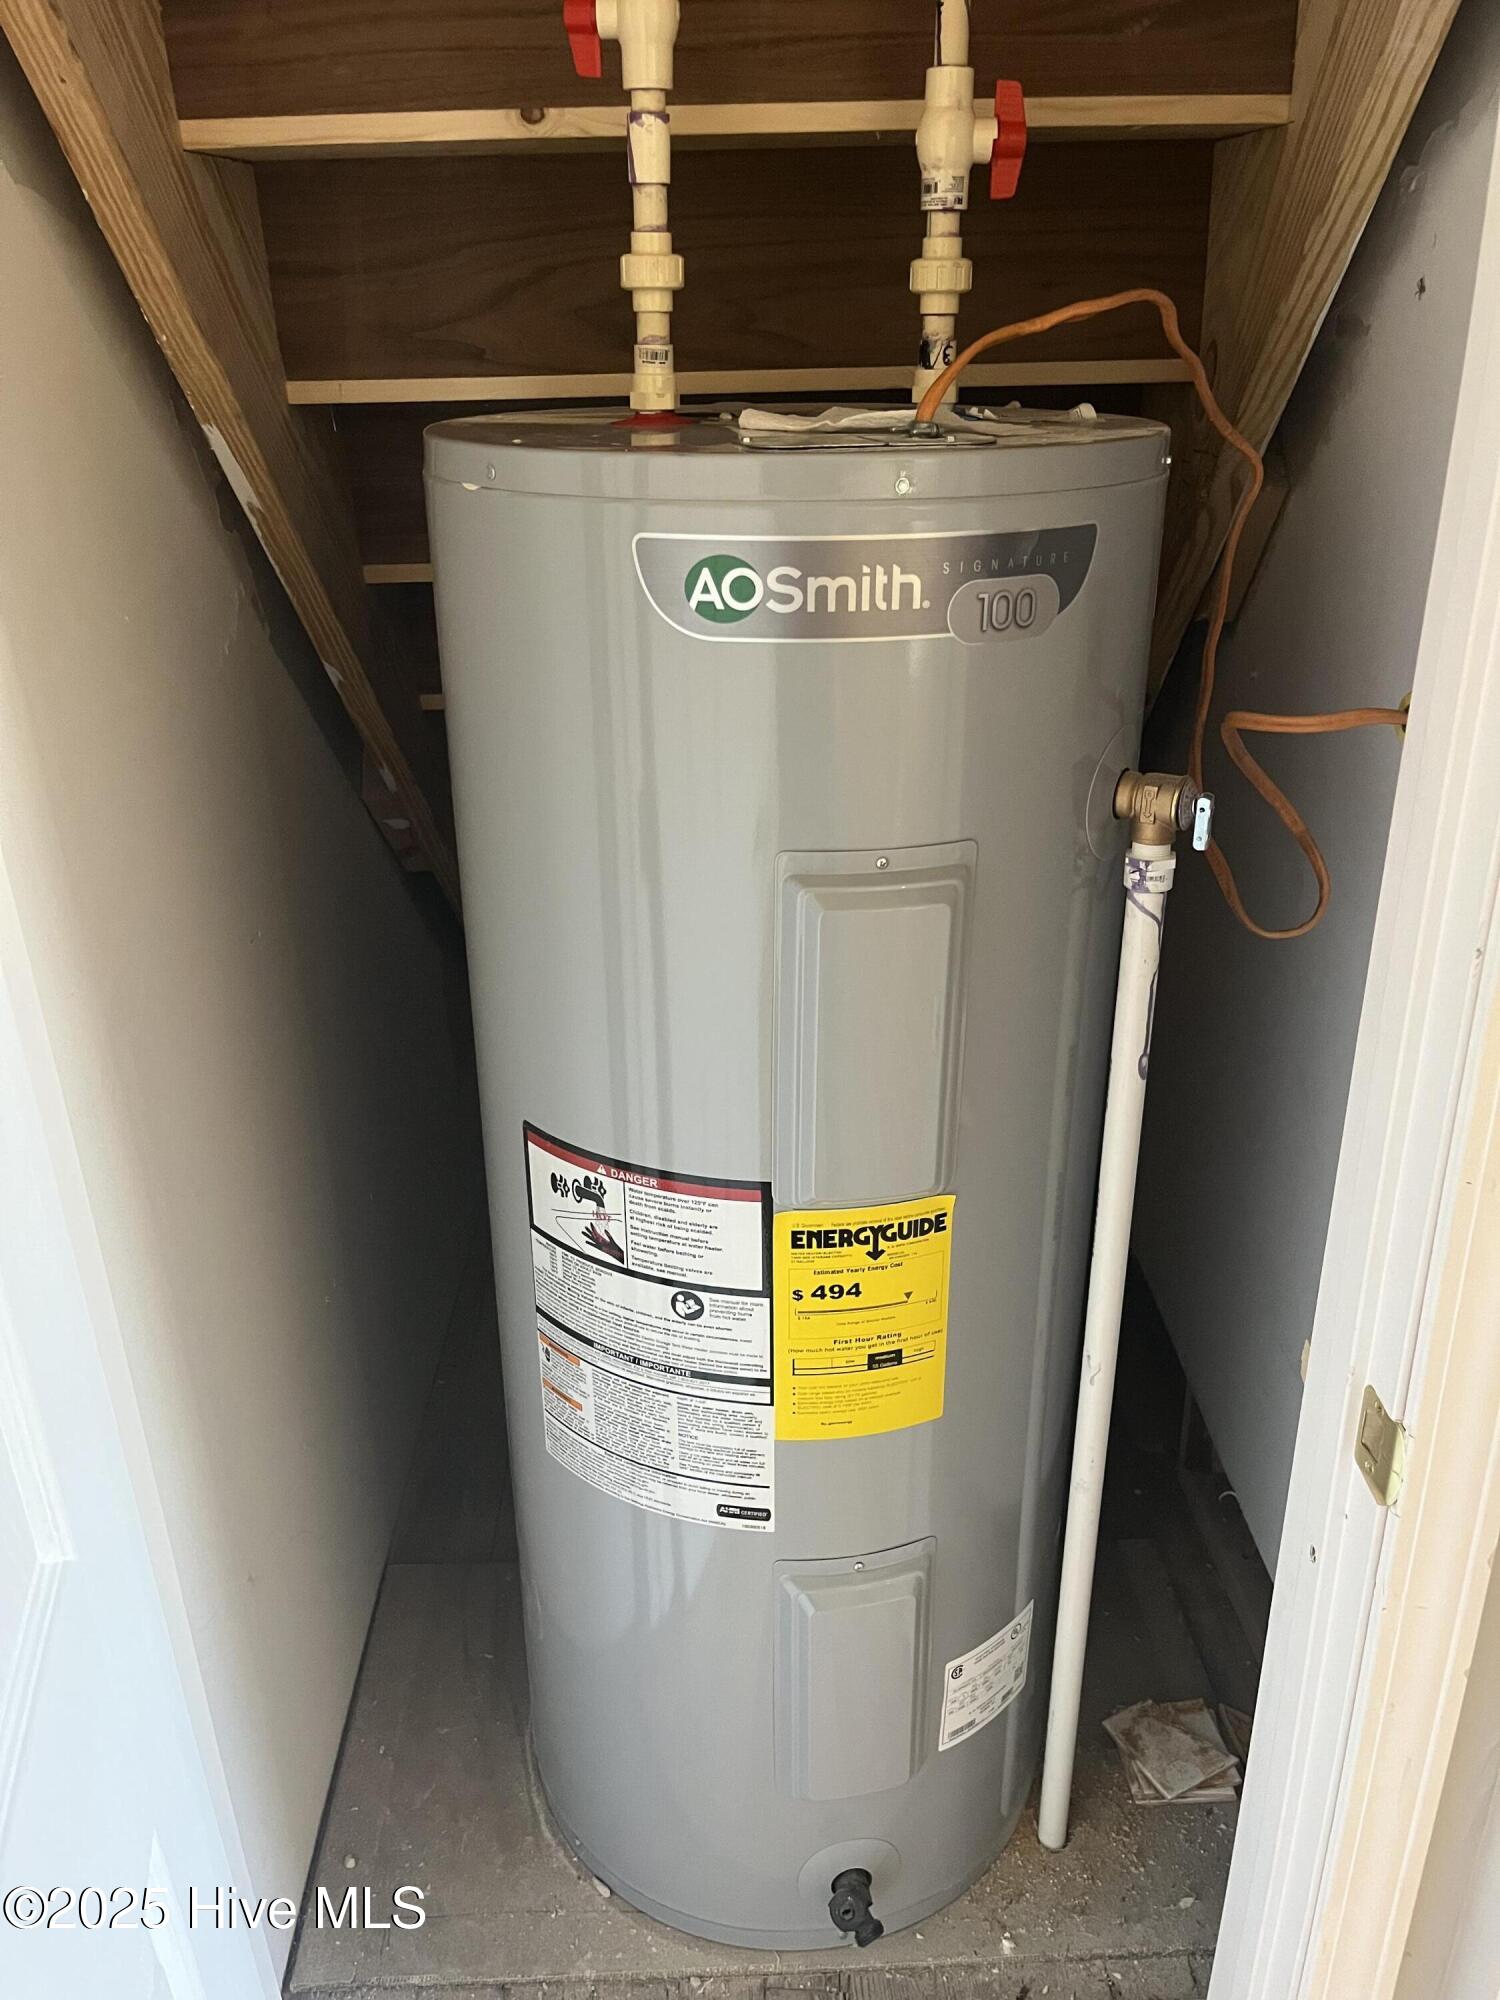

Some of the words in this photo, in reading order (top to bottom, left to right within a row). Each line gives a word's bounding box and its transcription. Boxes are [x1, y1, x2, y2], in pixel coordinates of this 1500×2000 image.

[943, 551, 1072, 575] SIGNATURE
[977, 587, 1037, 631] 100
[610, 1168, 658, 1188] DANGER
[790, 1212, 948, 1254] ENERGYGUIDE
[846, 1266, 865, 1274] Yearly
[867, 1264, 888, 1272] Energy
[889, 1261, 904, 1269] Cost
[792, 1289, 804, 1301] $
[810, 1282, 862, 1300] 494
[877, 1332, 902, 1341] Rating
[593, 1342, 634, 1364] IMPORTANT
[640, 1359, 692, 1378] IMPORTANTE
